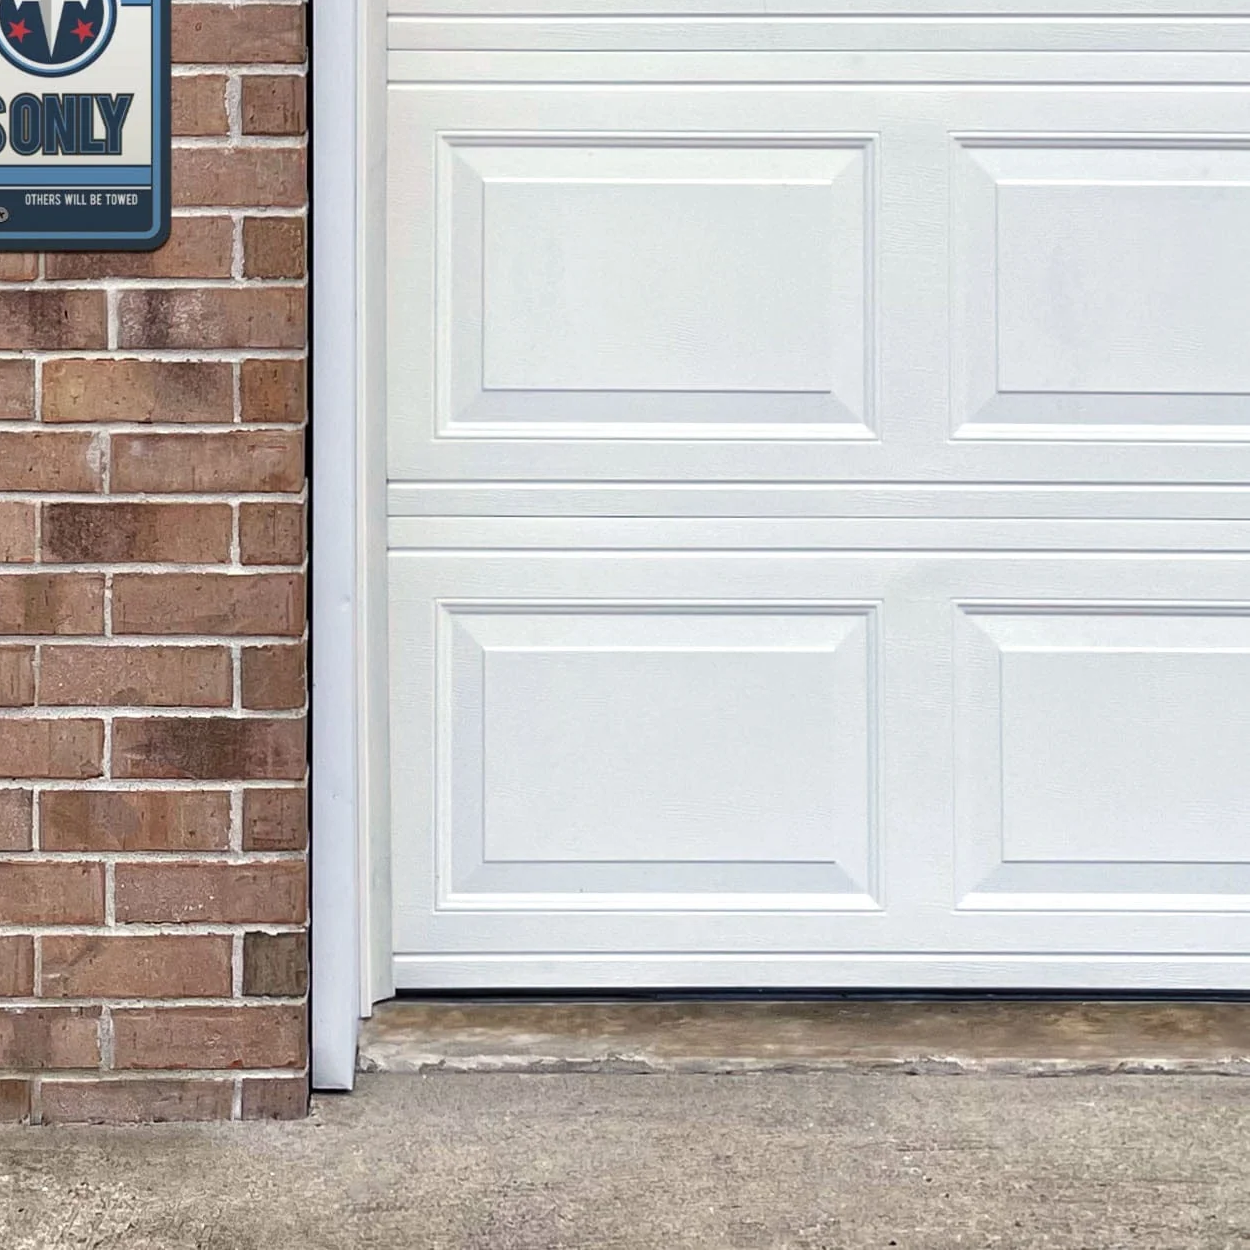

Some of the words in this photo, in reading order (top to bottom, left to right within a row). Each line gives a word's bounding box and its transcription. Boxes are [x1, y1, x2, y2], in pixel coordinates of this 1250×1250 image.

[9, 92, 135, 156] ONLY
[24, 193, 61, 206] OTHERS
[64, 193, 87, 206] WILL
[90, 193, 102, 206] BE
[105, 193, 138, 206] TOWED
